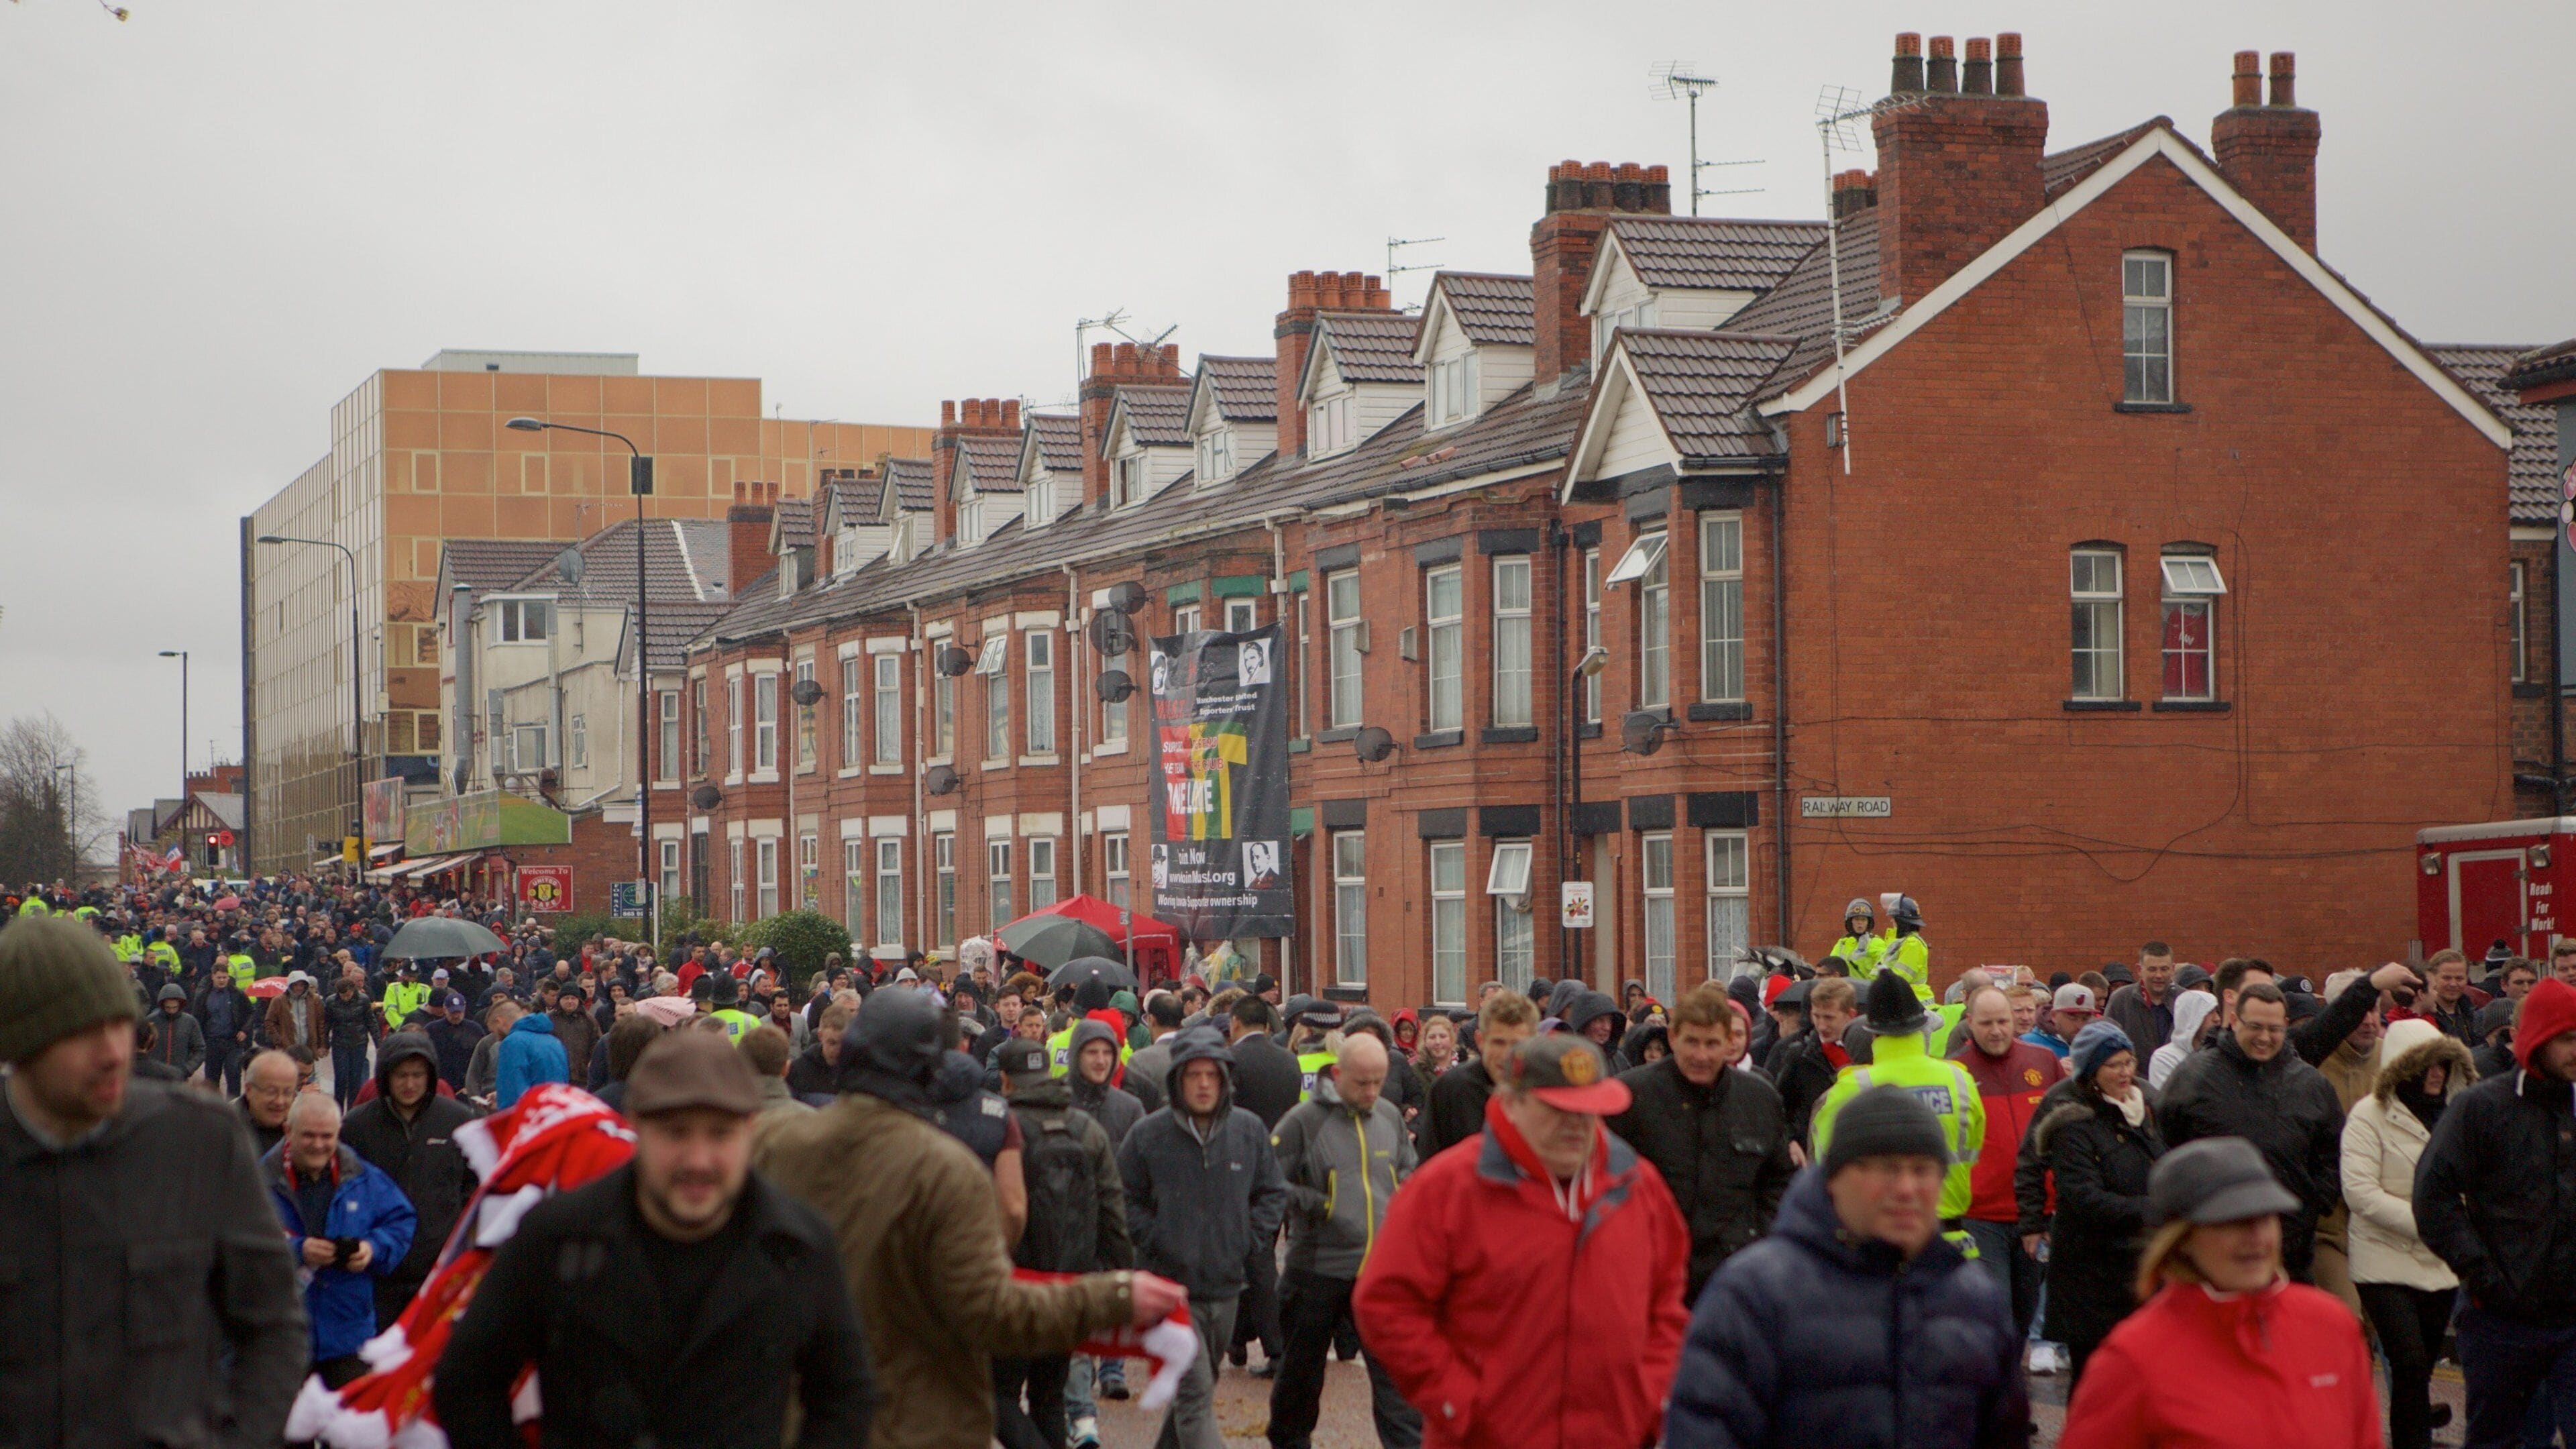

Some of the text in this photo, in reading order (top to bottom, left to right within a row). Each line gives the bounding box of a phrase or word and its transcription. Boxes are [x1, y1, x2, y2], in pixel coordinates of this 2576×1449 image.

[1201, 758, 1224, 771] CUB
[1803, 801, 1888, 813] RAILWAY ROAD
[532, 877, 558, 886] UNITED
[1210, 893, 1258, 908] ownership
[2536, 900, 2549, 914] For
[2532, 917, 2555, 931] Work!
